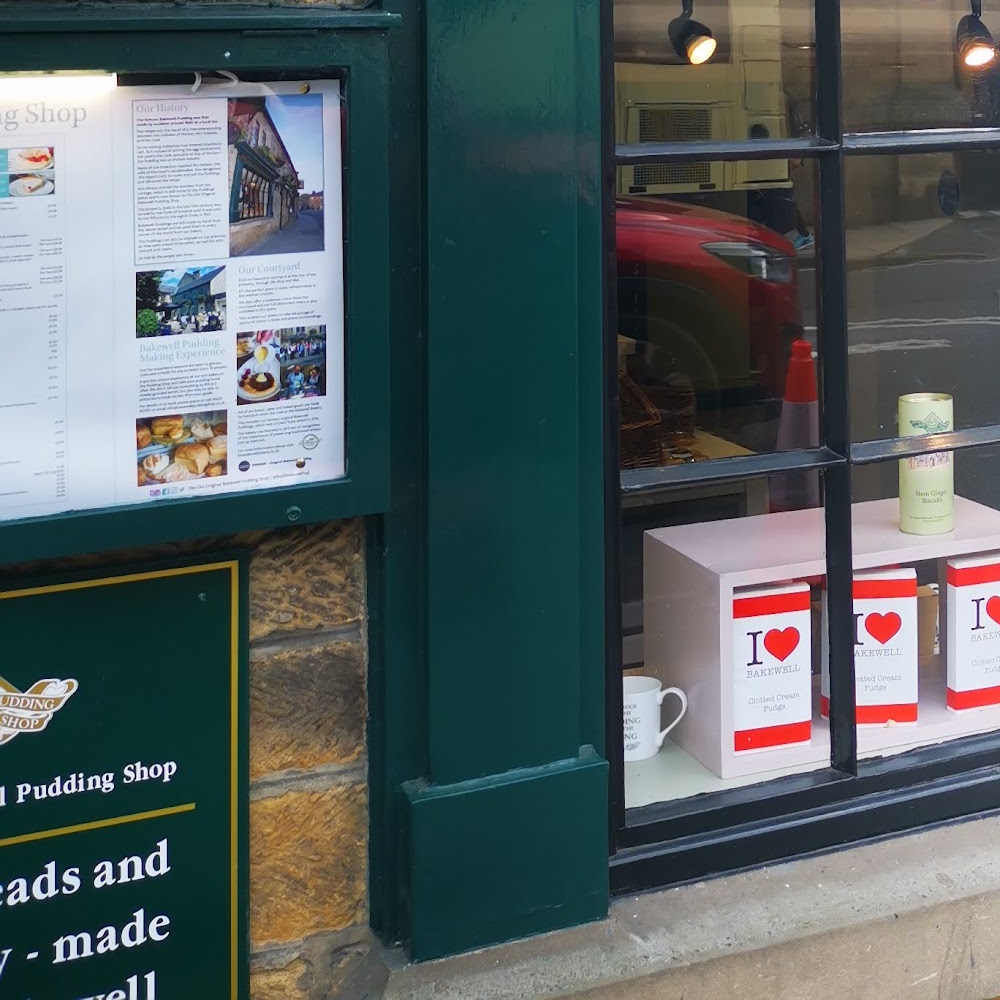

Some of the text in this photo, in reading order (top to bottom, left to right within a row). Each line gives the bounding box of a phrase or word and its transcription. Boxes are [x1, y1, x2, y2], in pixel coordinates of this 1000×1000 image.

[25, 101, 87, 128] Shop
[136, 103, 190, 113] Our History
[238, 261, 301, 274] Our Courtyard
[139, 338, 221, 353] Bakewell Pudding
[139, 348, 226, 362] Making Experience
[930, 489, 948, 497] Ginger
[971, 597, 985, 631] I
[746, 630, 763, 667] I
[854, 647, 902, 658] AKEWELL
[746, 664, 800, 679] BAKEWELL
[877, 674, 902, 682] Cream
[864, 684, 887, 692] Fudge
[748, 691, 801, 706] Clotted Cream
[763, 704, 786, 713] Fudge
[2, 713, 40, 729] SHOP
[16, 771, 115, 804] Pudding
[123, 760, 178, 784] Shop
[0, 838, 171, 907] ads and
[52, 908, 171, 964] made
